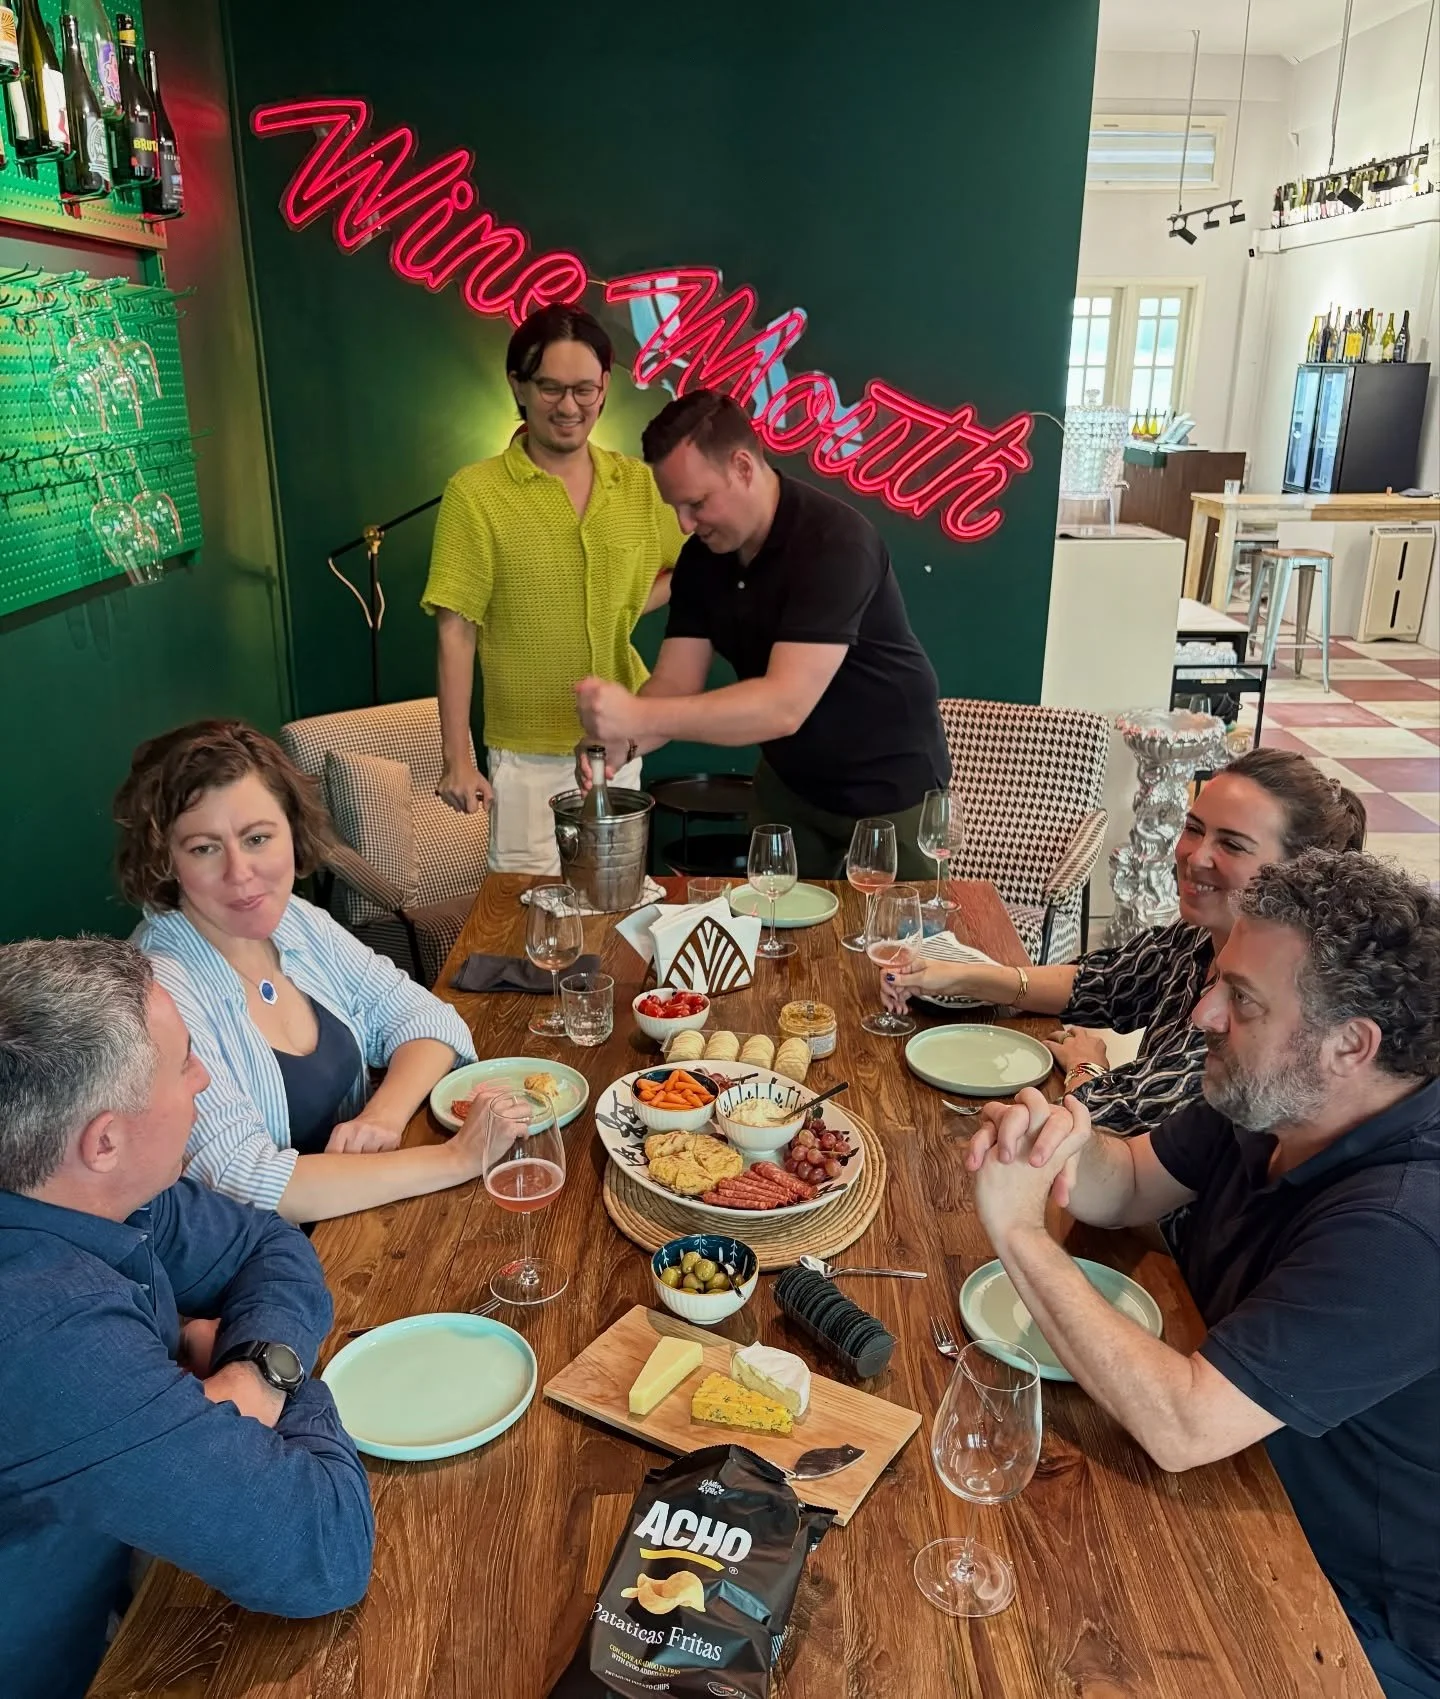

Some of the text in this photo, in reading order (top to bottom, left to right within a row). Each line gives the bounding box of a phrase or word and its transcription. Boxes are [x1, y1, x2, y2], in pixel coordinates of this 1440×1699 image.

[253, 100, 1032, 540] Wine Mouth
[634, 1500, 752, 1563] ACHO
[590, 1602, 722, 1661] Pataticas Fritas
[611, 1652, 626, 1665] WITH
[653, 1683, 670, 1691] CHIPS
